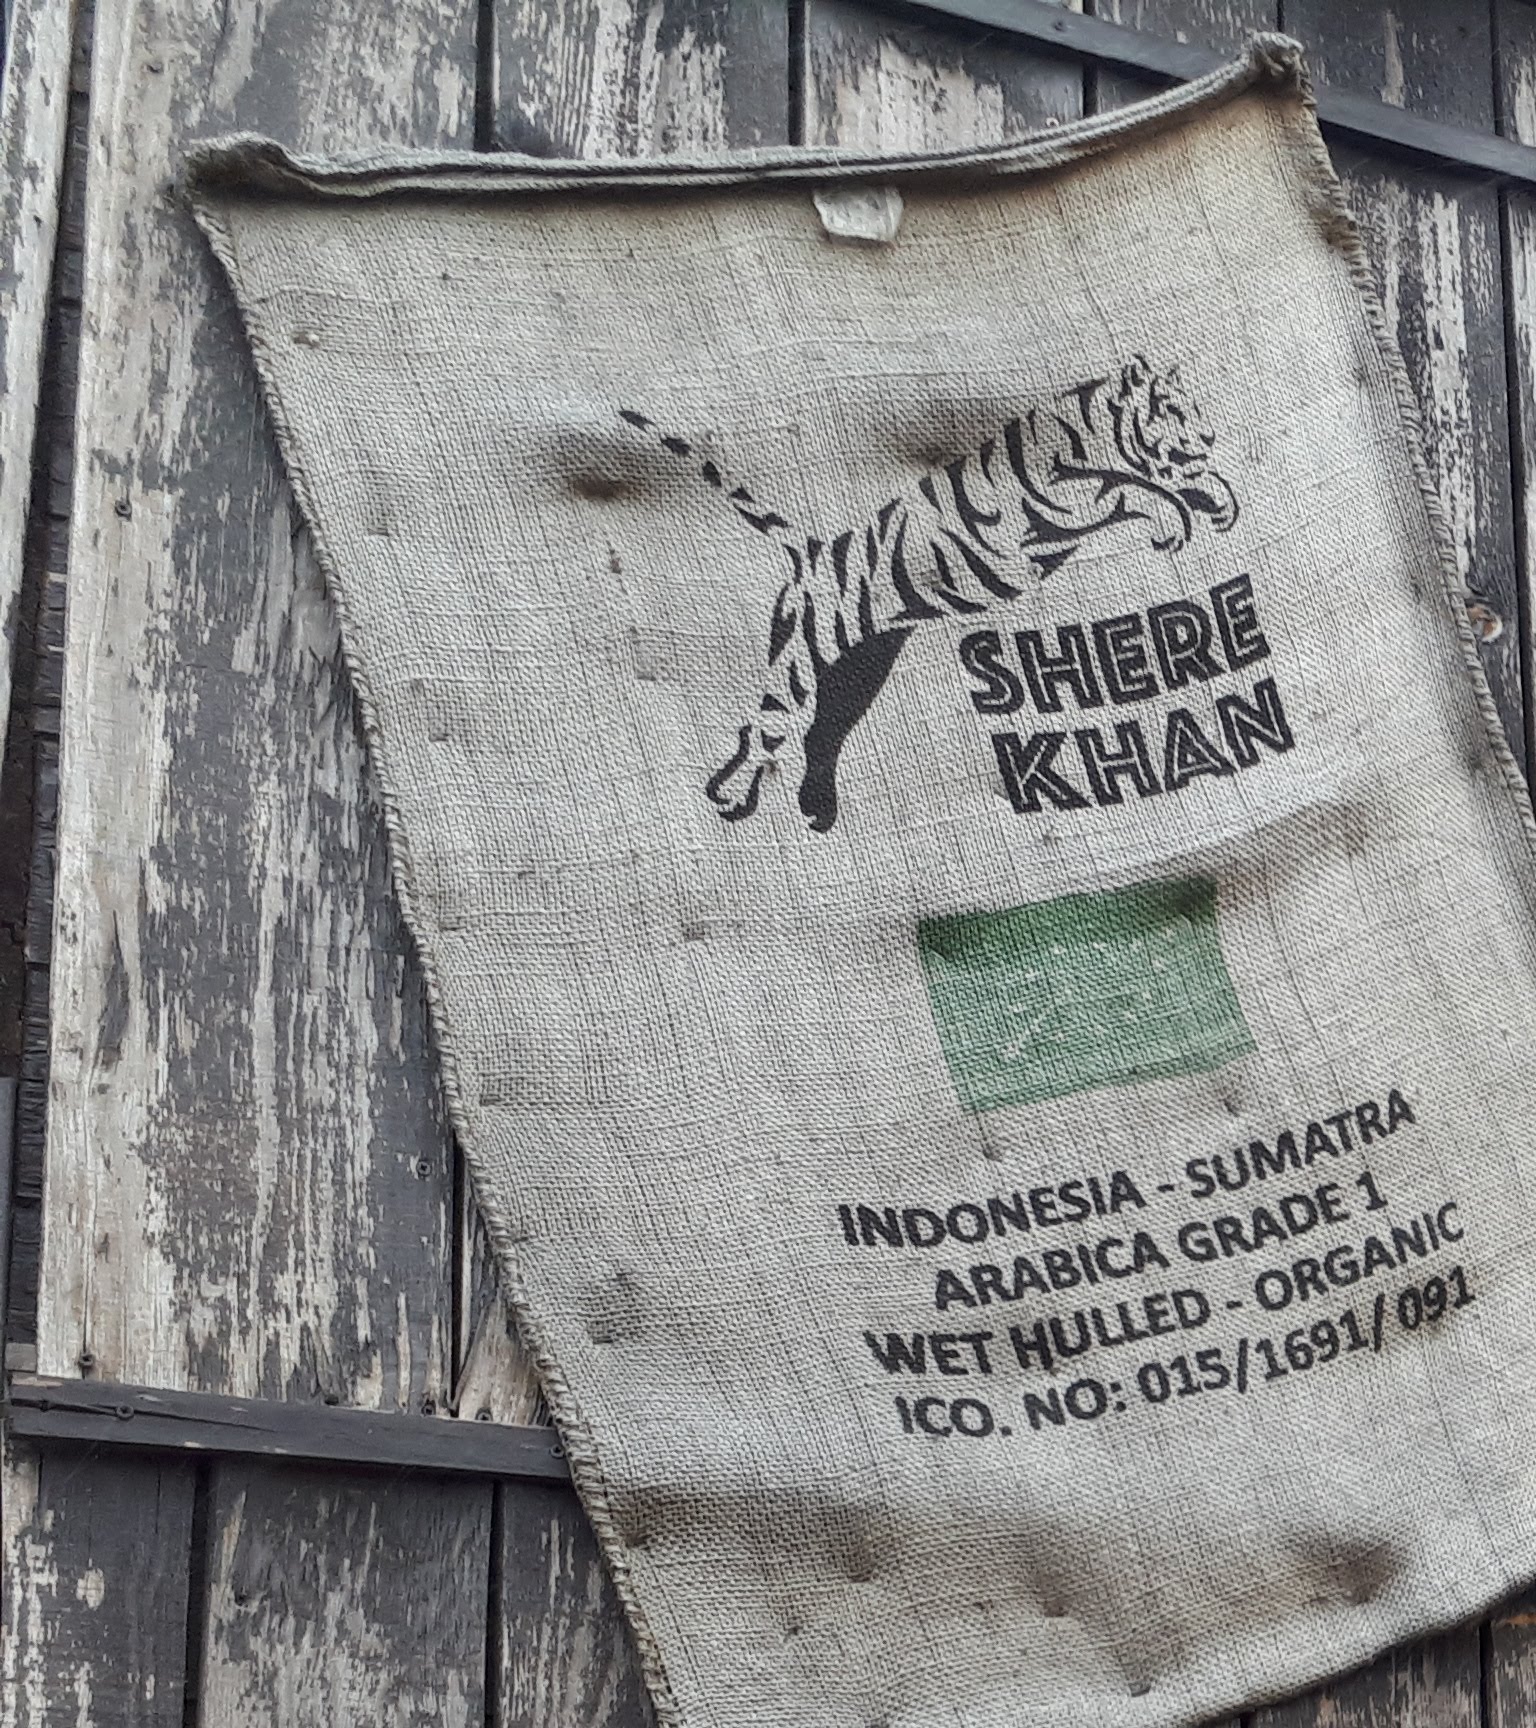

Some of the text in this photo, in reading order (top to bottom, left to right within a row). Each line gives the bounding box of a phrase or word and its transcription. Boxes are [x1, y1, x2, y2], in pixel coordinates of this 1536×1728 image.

[959, 573, 1273, 716] SHERE
[992, 678, 1296, 815] KHAN
[838, 1171, 1147, 1249] INDONESIA
[1184, 1088, 1418, 1200] SUMATRA
[863, 1329, 994, 1376] WET
[1012, 1289, 1211, 1370] HULLED
[1254, 1203, 1465, 1310] ORGANIC
[934, 1171, 1388, 1312] ARABICA GRADE 1
[896, 1396, 1012, 1438] ICO.
[1024, 1378, 1126, 1432] NO:
